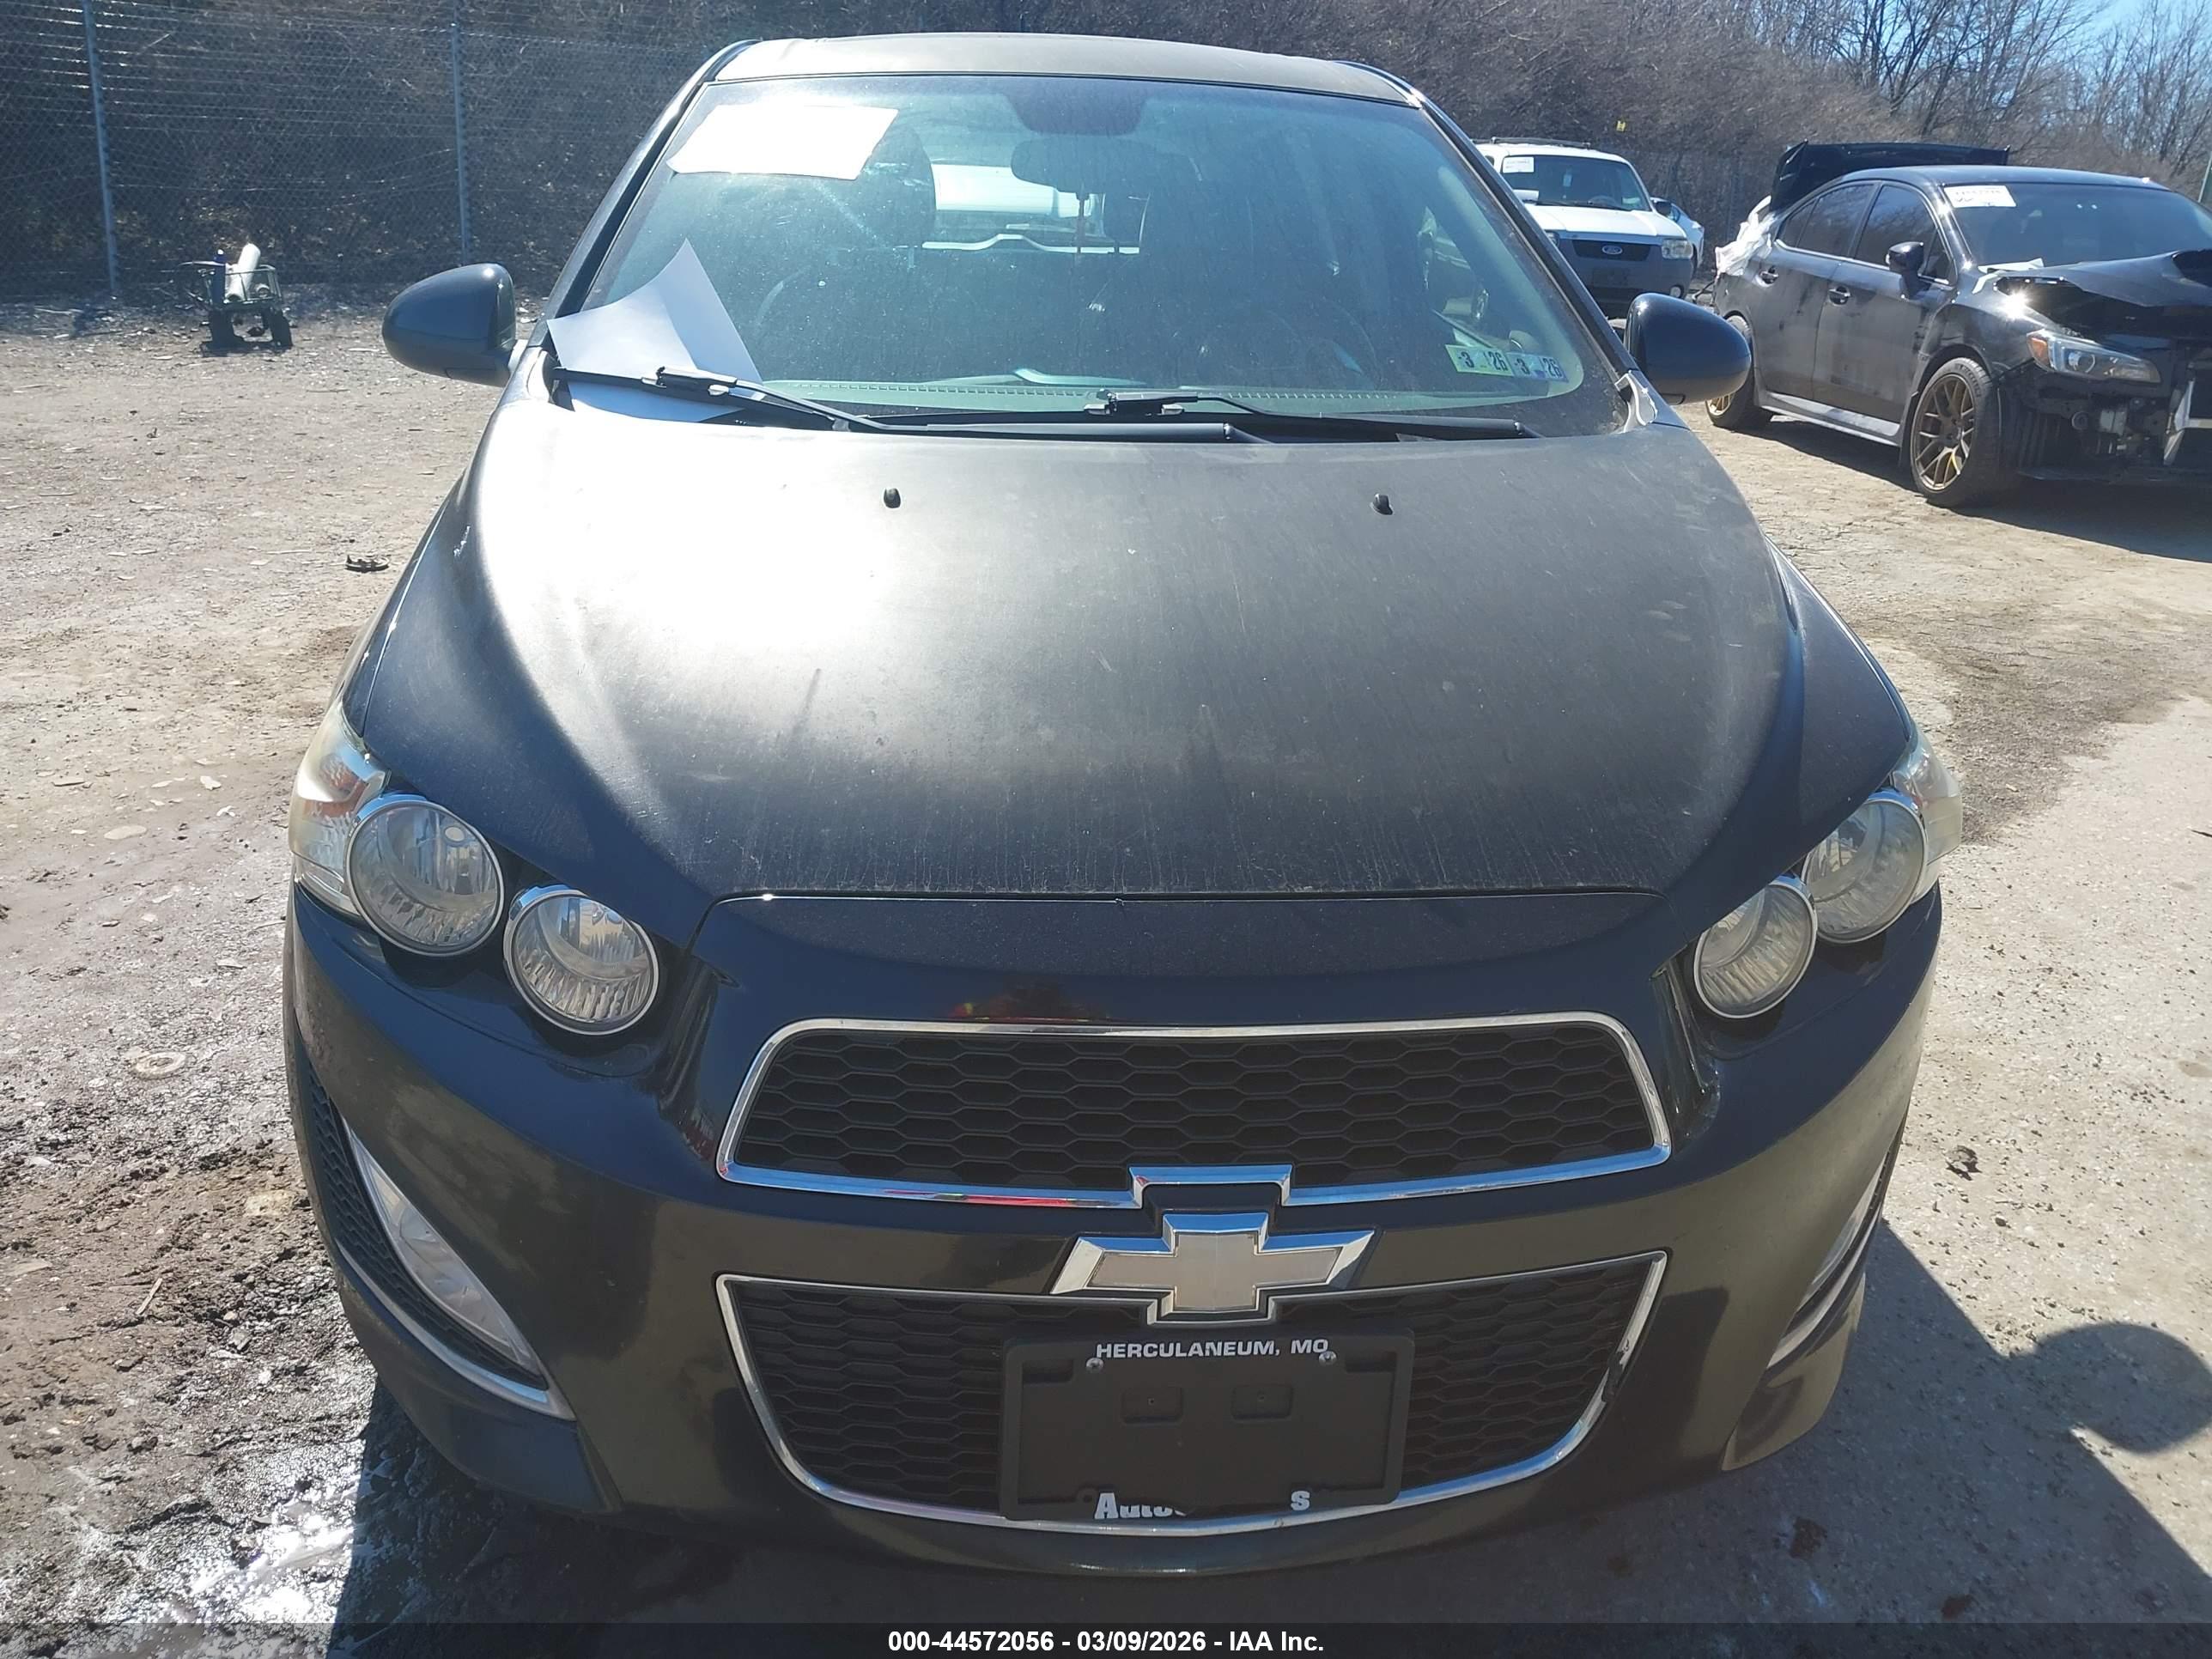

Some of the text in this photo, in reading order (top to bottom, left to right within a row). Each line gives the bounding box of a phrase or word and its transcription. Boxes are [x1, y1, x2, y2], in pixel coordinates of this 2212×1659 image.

[1488, 351, 1509, 372] 26
[1097, 1339, 1328, 1358] HERCULANEUM, MO
